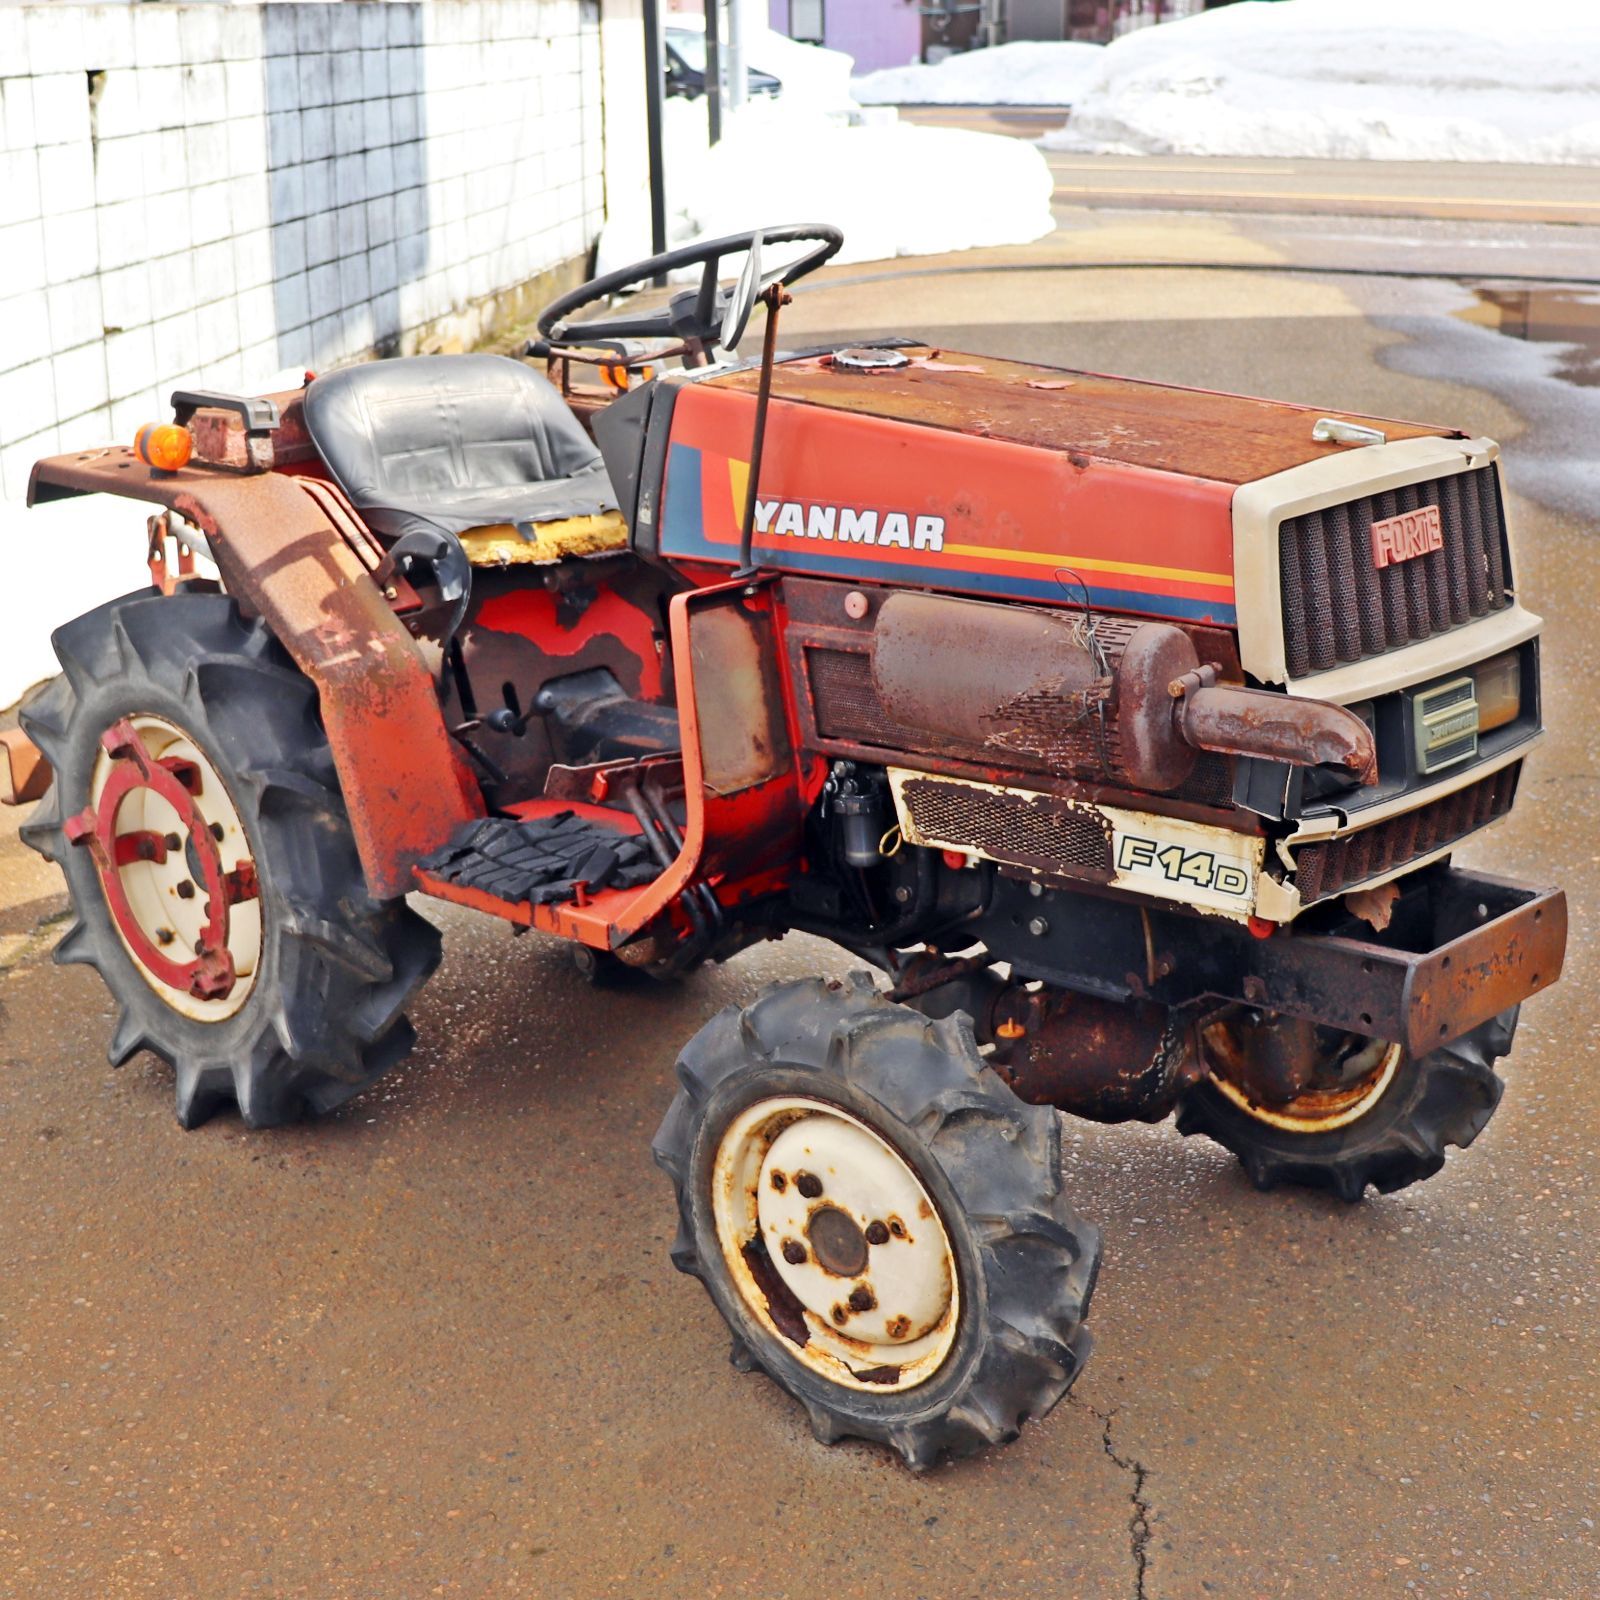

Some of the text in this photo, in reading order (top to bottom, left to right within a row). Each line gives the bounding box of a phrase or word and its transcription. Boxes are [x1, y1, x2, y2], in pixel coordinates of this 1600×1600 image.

[754, 499, 945, 552] YANMAR
[1372, 505, 1443, 569] FORTE
[1118, 835, 1248, 895] F14D
